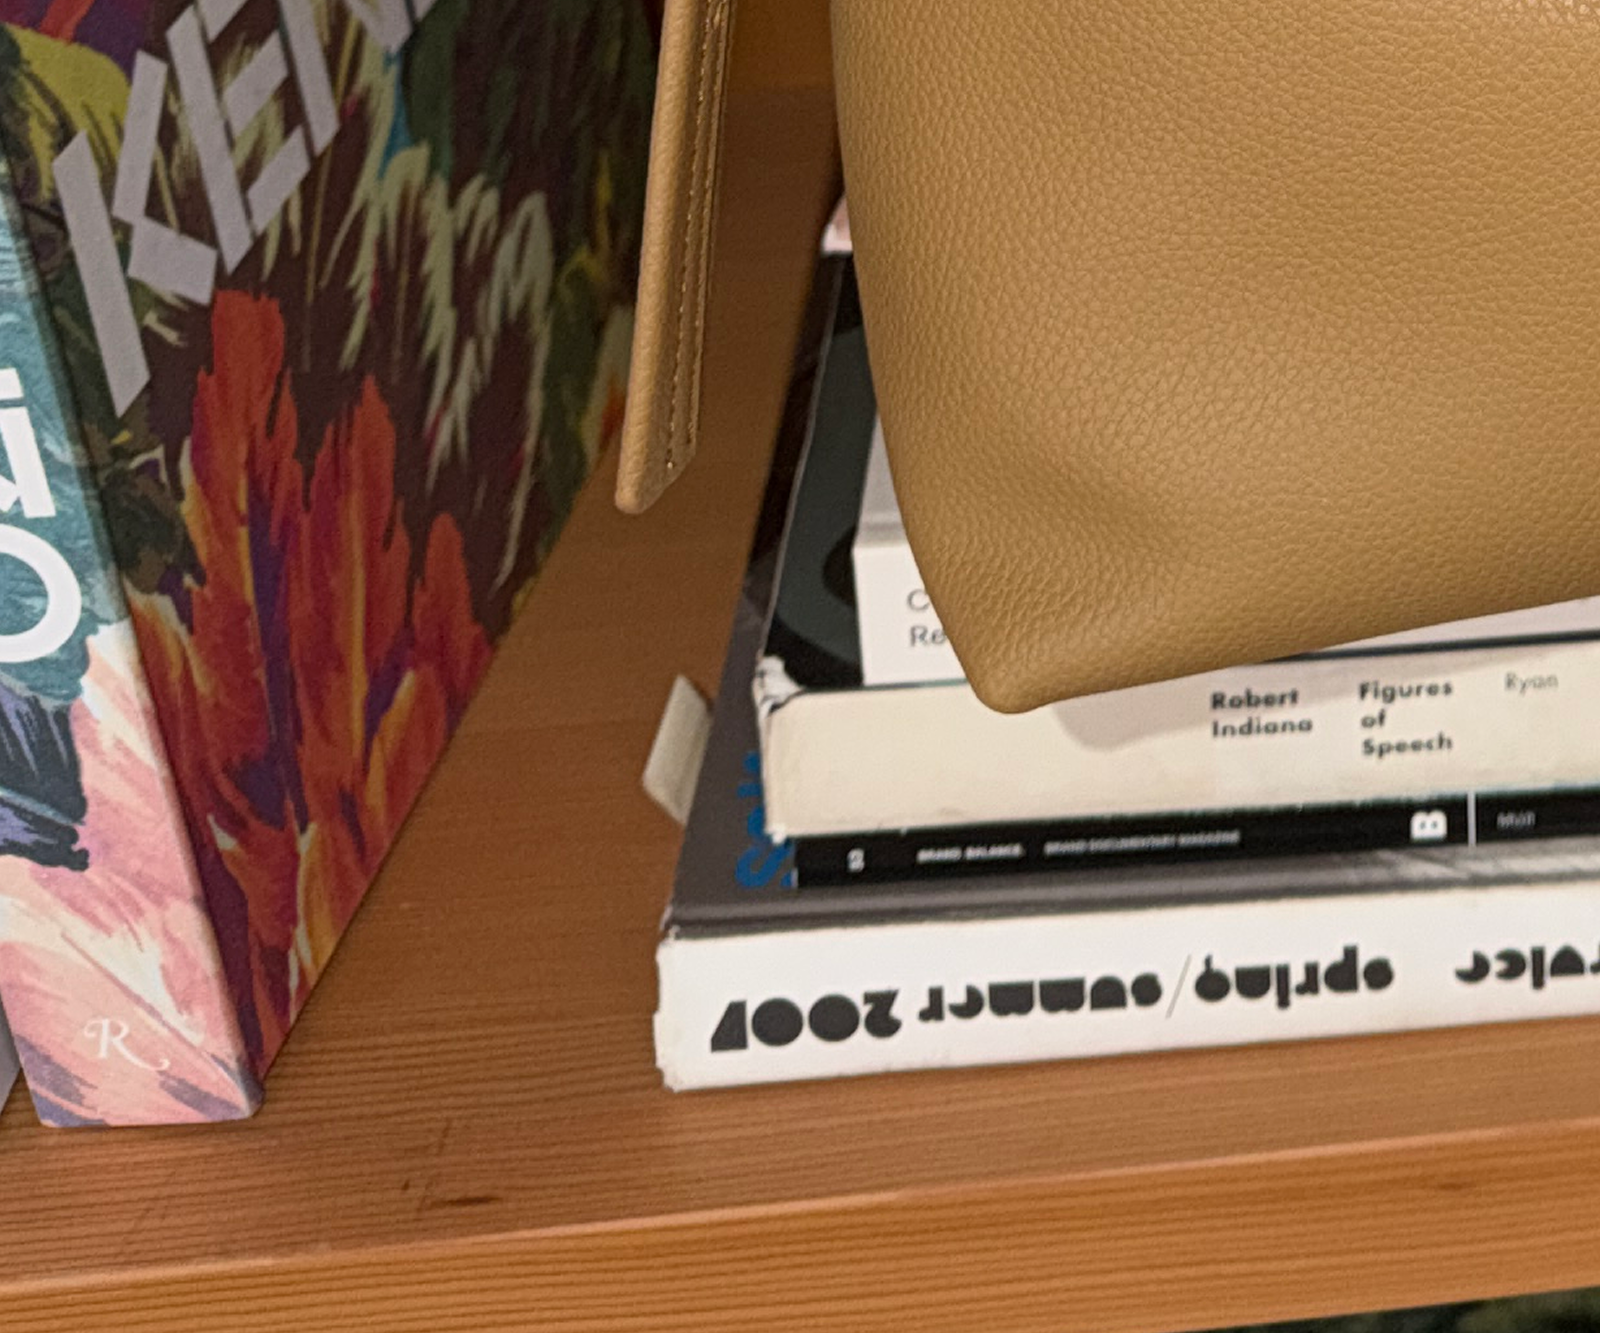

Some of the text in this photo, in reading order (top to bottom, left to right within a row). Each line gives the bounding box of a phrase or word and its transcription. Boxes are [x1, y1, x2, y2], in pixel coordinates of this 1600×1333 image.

[1359, 680, 1453, 704] Figures
[1505, 672, 1559, 699] Ryan
[1211, 689, 1299, 711] Robert
[1212, 717, 1313, 739] Indiana
[1361, 709, 1386, 729] of
[1362, 732, 1453, 759] Speech
[711, 989, 901, 1052] 2007
